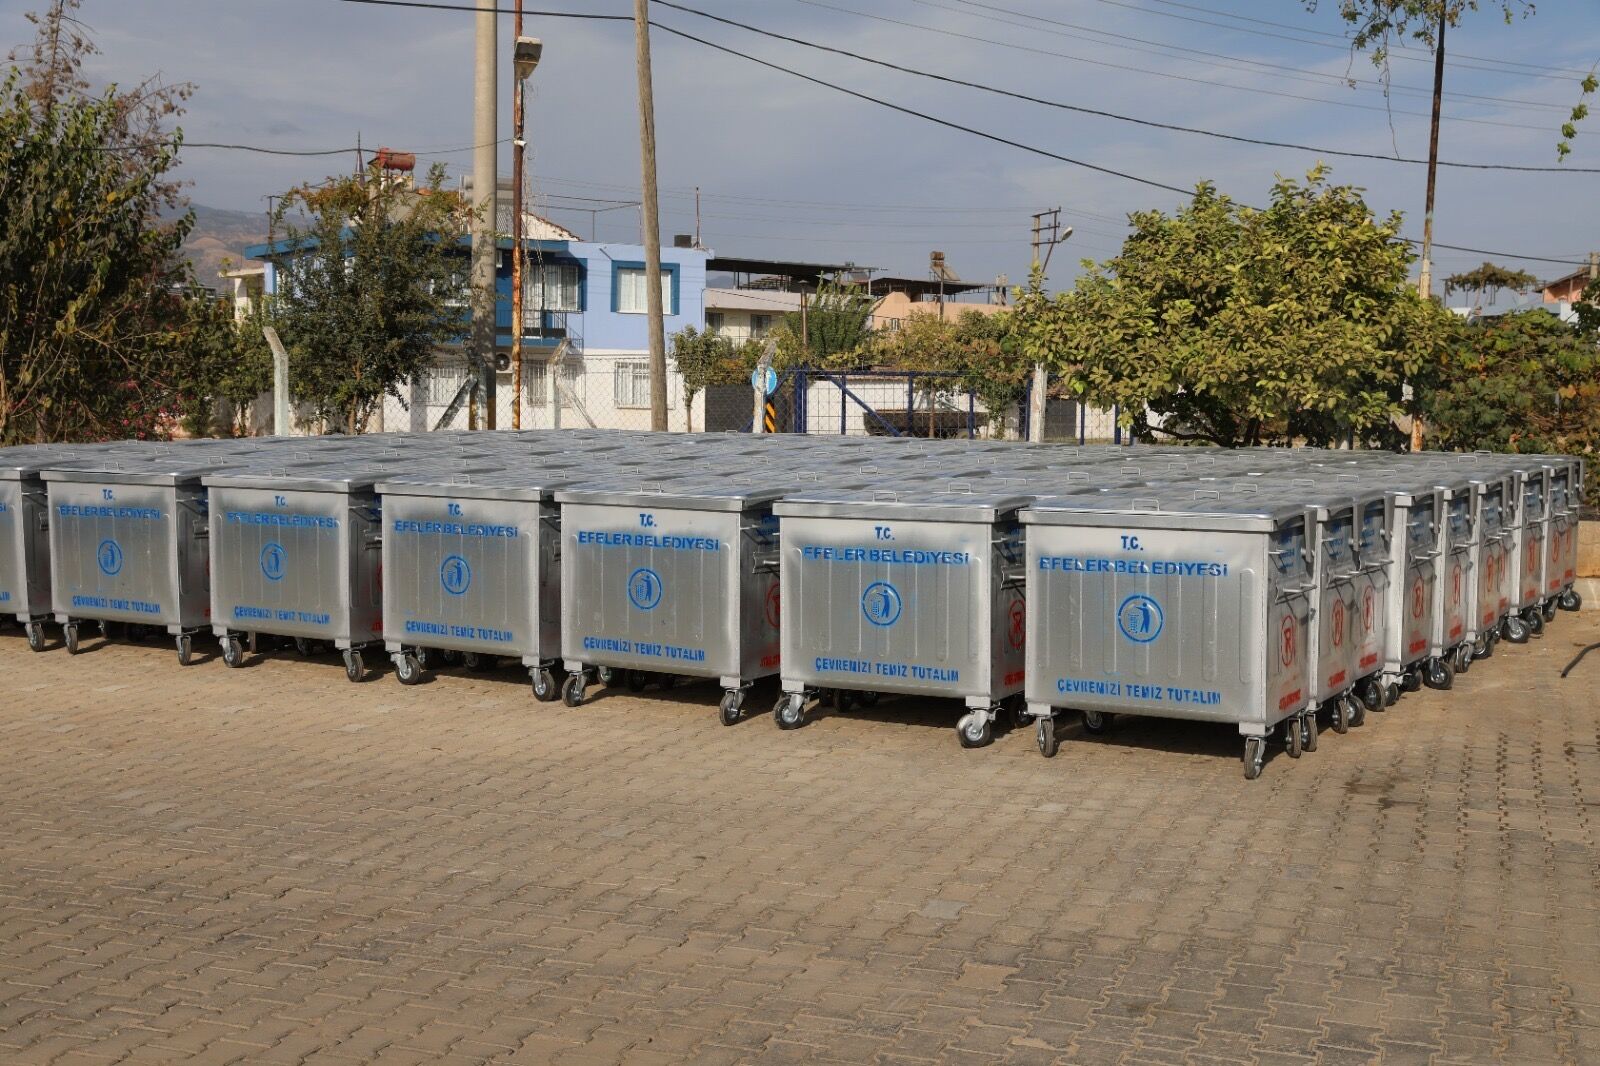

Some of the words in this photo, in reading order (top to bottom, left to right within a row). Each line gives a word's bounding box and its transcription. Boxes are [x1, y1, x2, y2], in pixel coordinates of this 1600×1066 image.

[578, 531, 632, 546] EFELER
[875, 527, 895, 540] T.C.
[1121, 535, 1144, 551] T.C.
[804, 547, 865, 561] EFELER
[1040, 557, 1110, 572] EFELER
[912, 666, 959, 682] TUTALIM
[1167, 688, 1221, 704] TUTALIM
